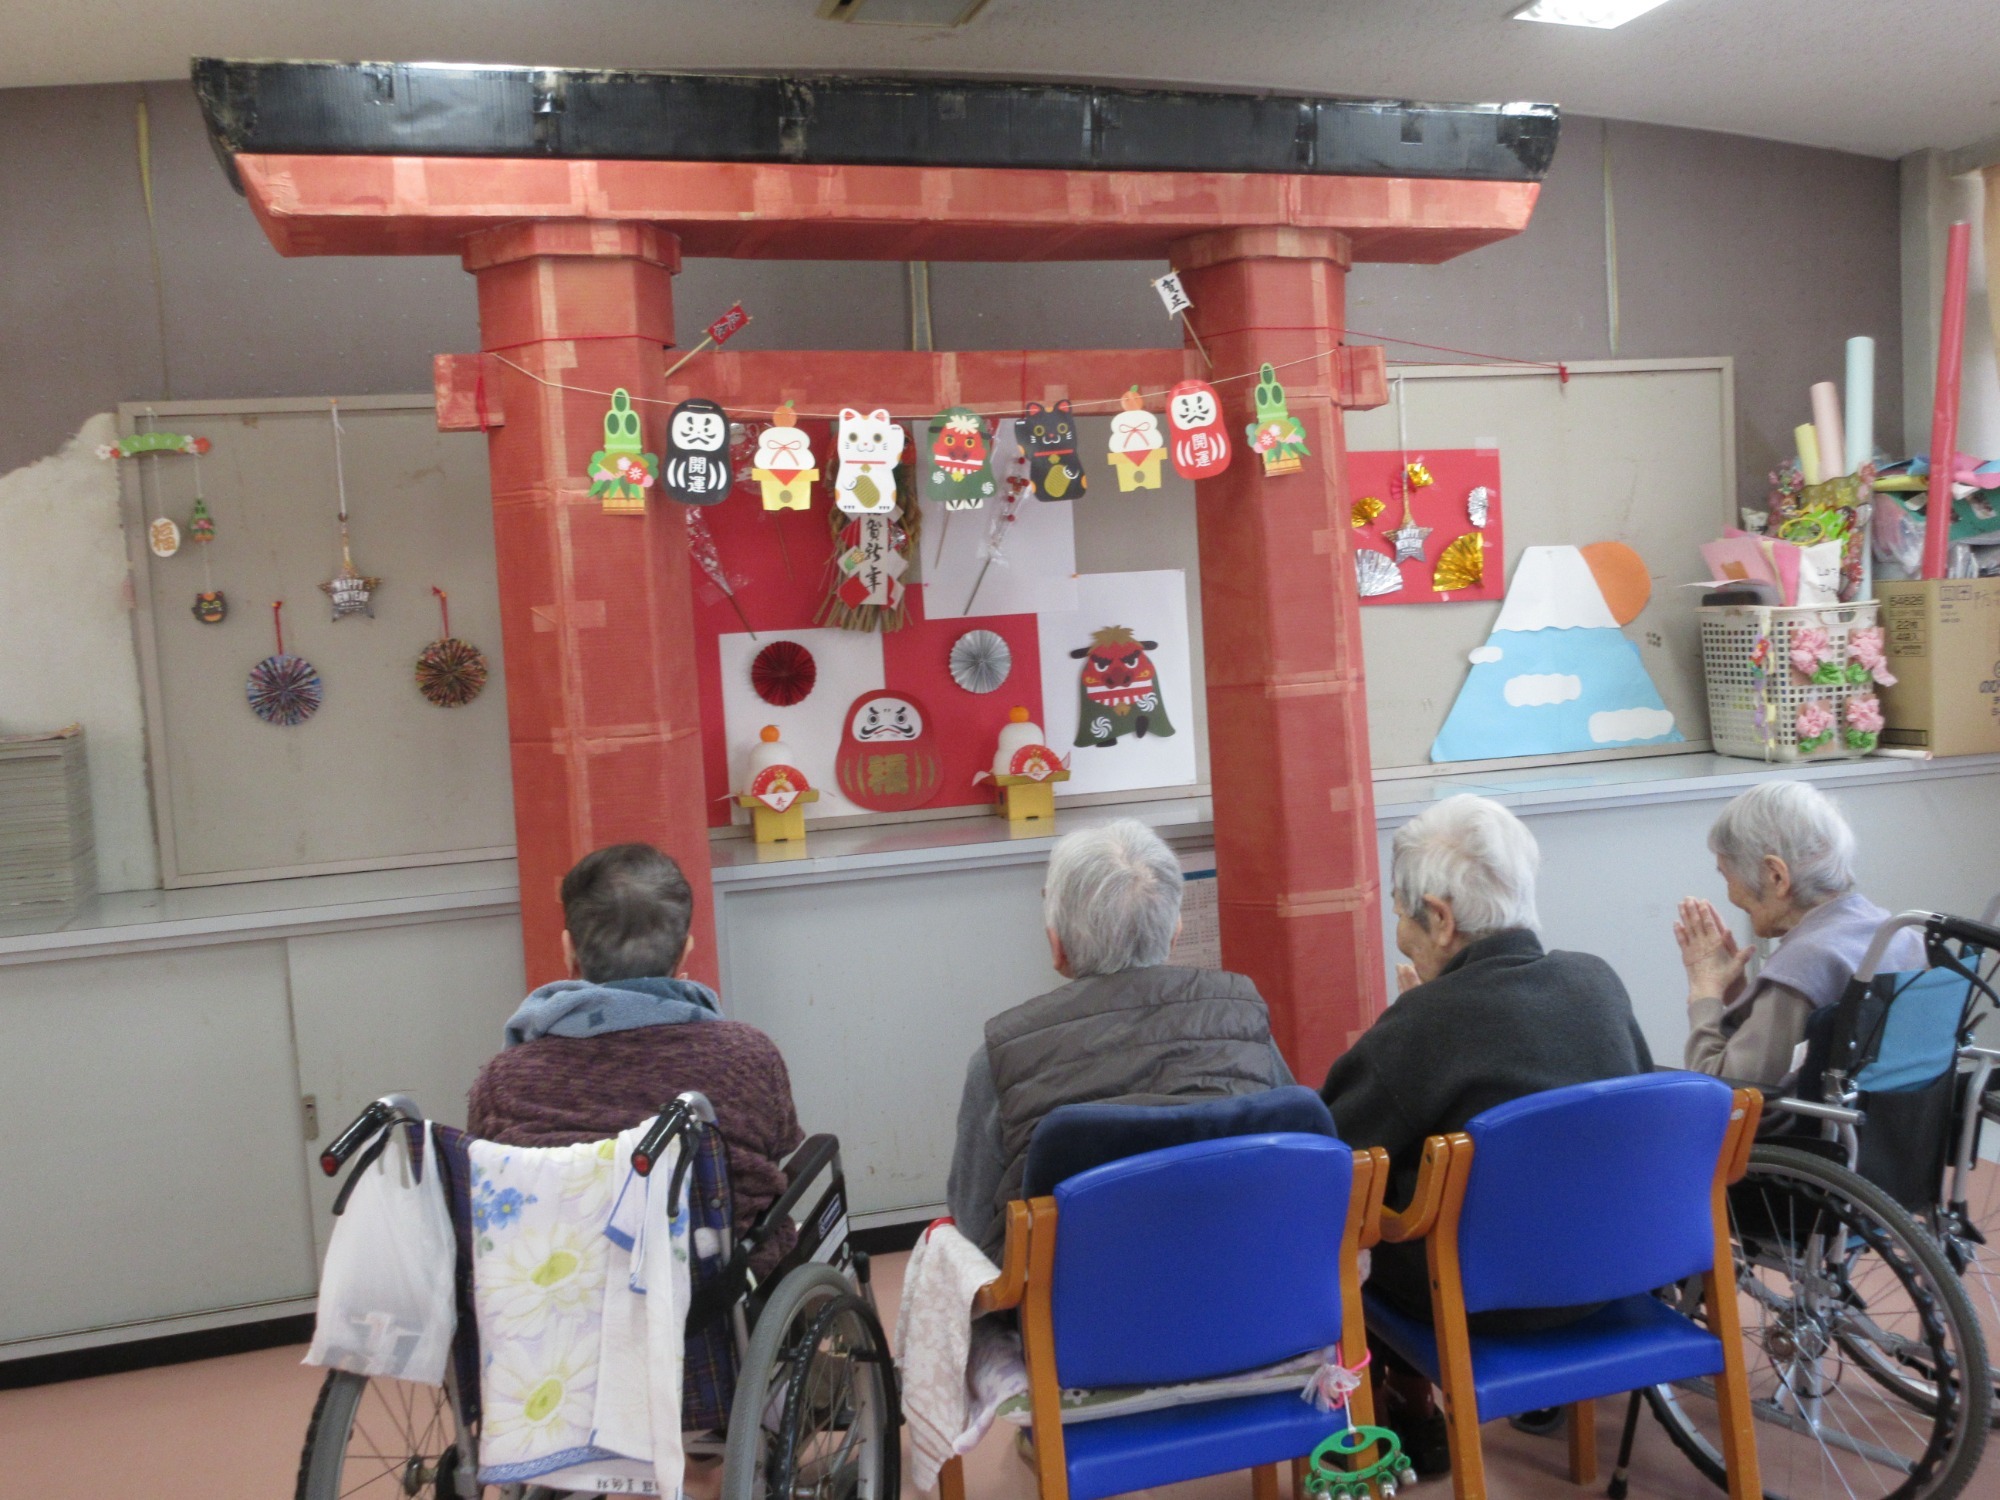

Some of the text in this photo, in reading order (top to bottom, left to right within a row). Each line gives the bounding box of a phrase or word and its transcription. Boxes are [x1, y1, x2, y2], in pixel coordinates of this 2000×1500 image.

[1161, 278, 1187, 310] 賀正
[687, 456, 707, 493] 開運
[863, 513, 883, 594] 賀新年
[867, 753, 909, 796] 福
